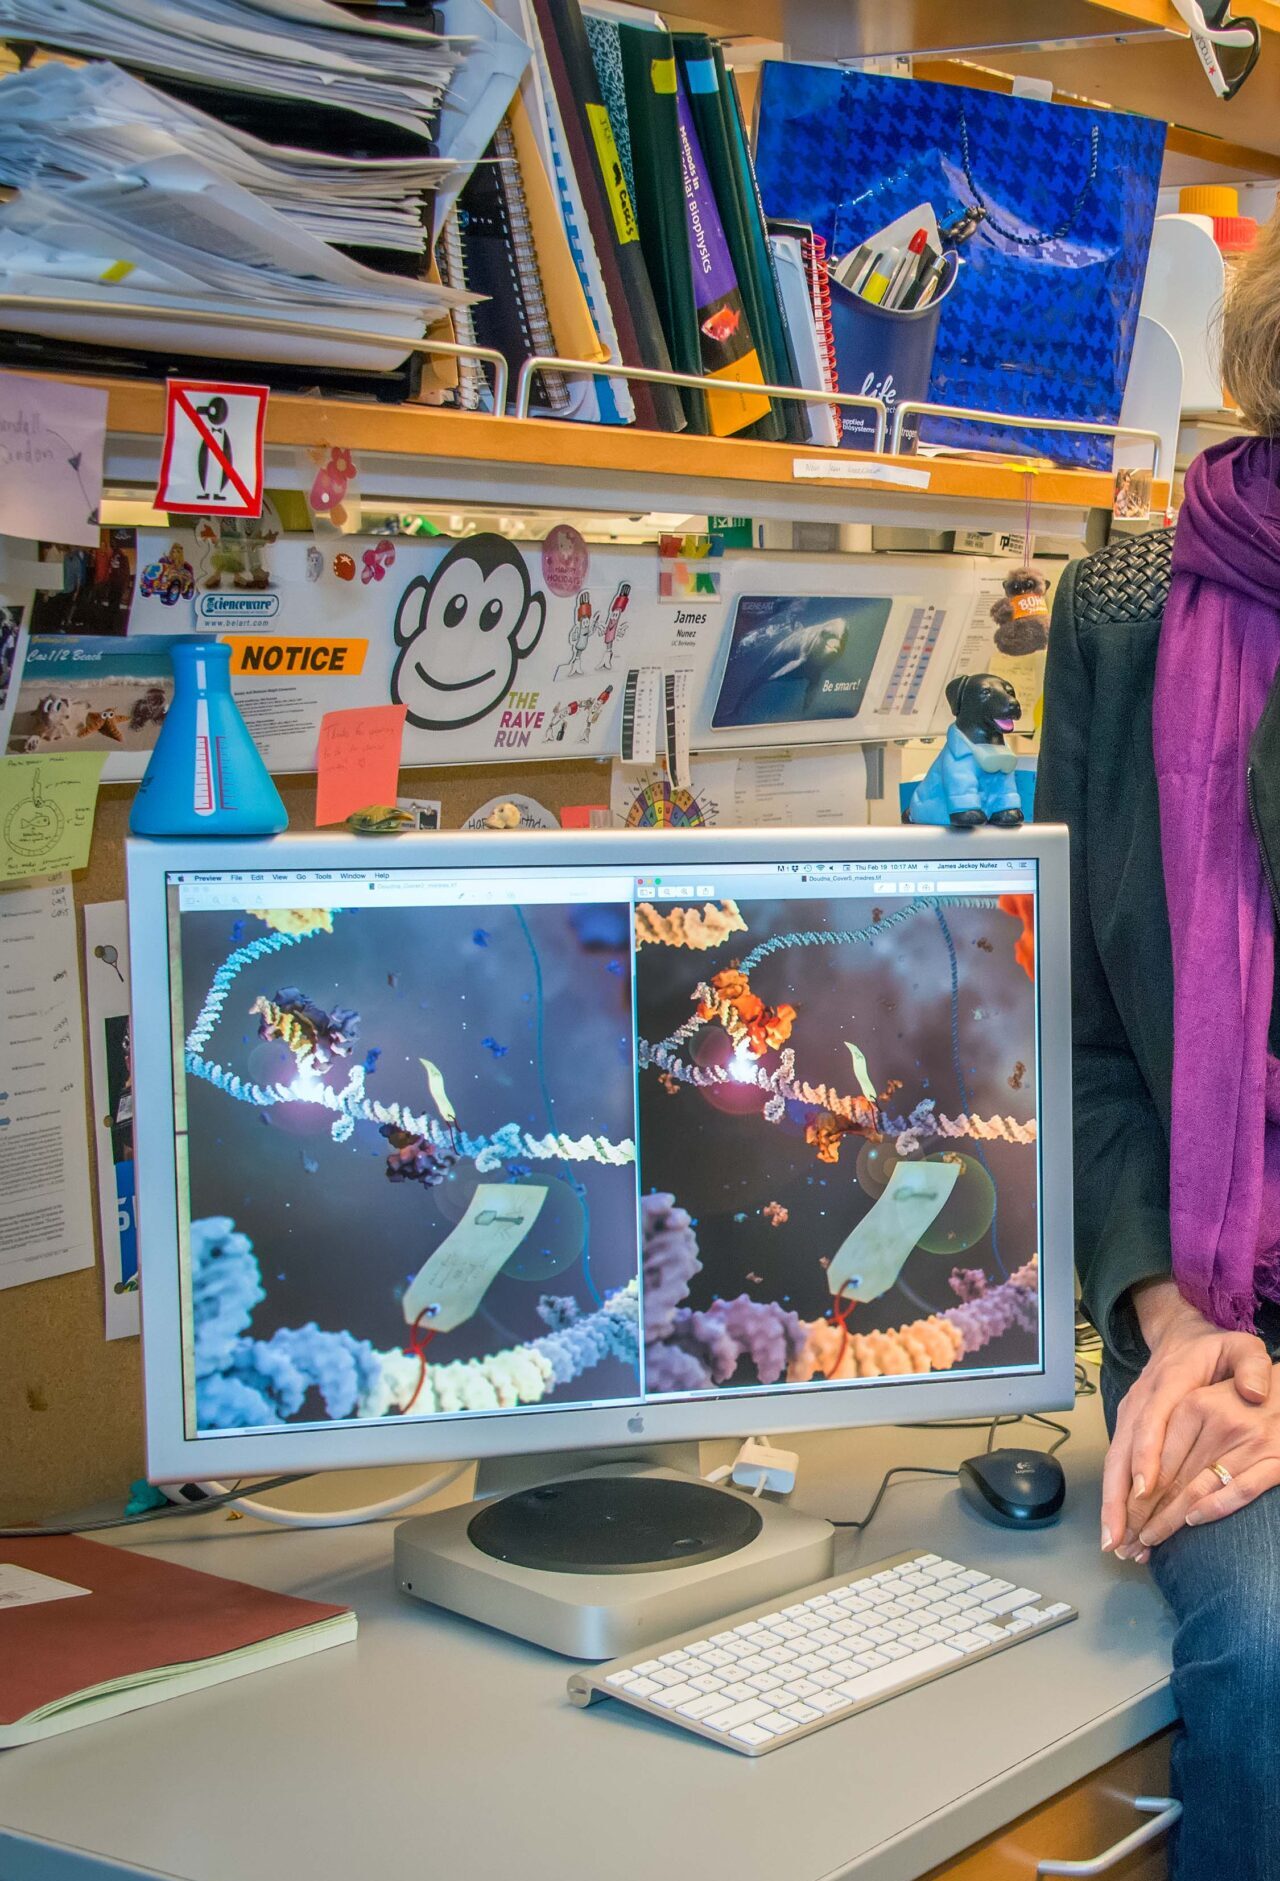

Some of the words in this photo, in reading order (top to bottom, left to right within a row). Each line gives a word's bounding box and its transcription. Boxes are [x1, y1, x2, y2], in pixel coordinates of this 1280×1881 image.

[679, 125, 697, 177] Methods
[692, 176, 700, 190] in
[689, 201, 712, 274] Biophysics
[858, 372, 897, 404] life
[842, 418, 864, 427] applied
[842, 424, 875, 434] biosystems
[205, 619, 269, 628] www.belart.com
[674, 610, 707, 625] James
[676, 629, 697, 638] Nunez
[241, 646, 348, 671] NOTICE
[822, 679, 833, 693] Be
[834, 679, 861, 692] smart!
[508, 691, 540, 709] THE
[500, 711, 545, 729] RAVE
[494, 730, 531, 748] RUN
[957, 862, 978, 870] Jeckoy
[194, 875, 222, 883] Preview
[231, 874, 242, 882] File
[251, 874, 263, 882] Edit
[272, 873, 288, 881] View
[296, 873, 306, 881] Go
[315, 872, 332, 880] Tools
[340, 872, 366, 880] Window
[375, 872, 390, 880] Help
